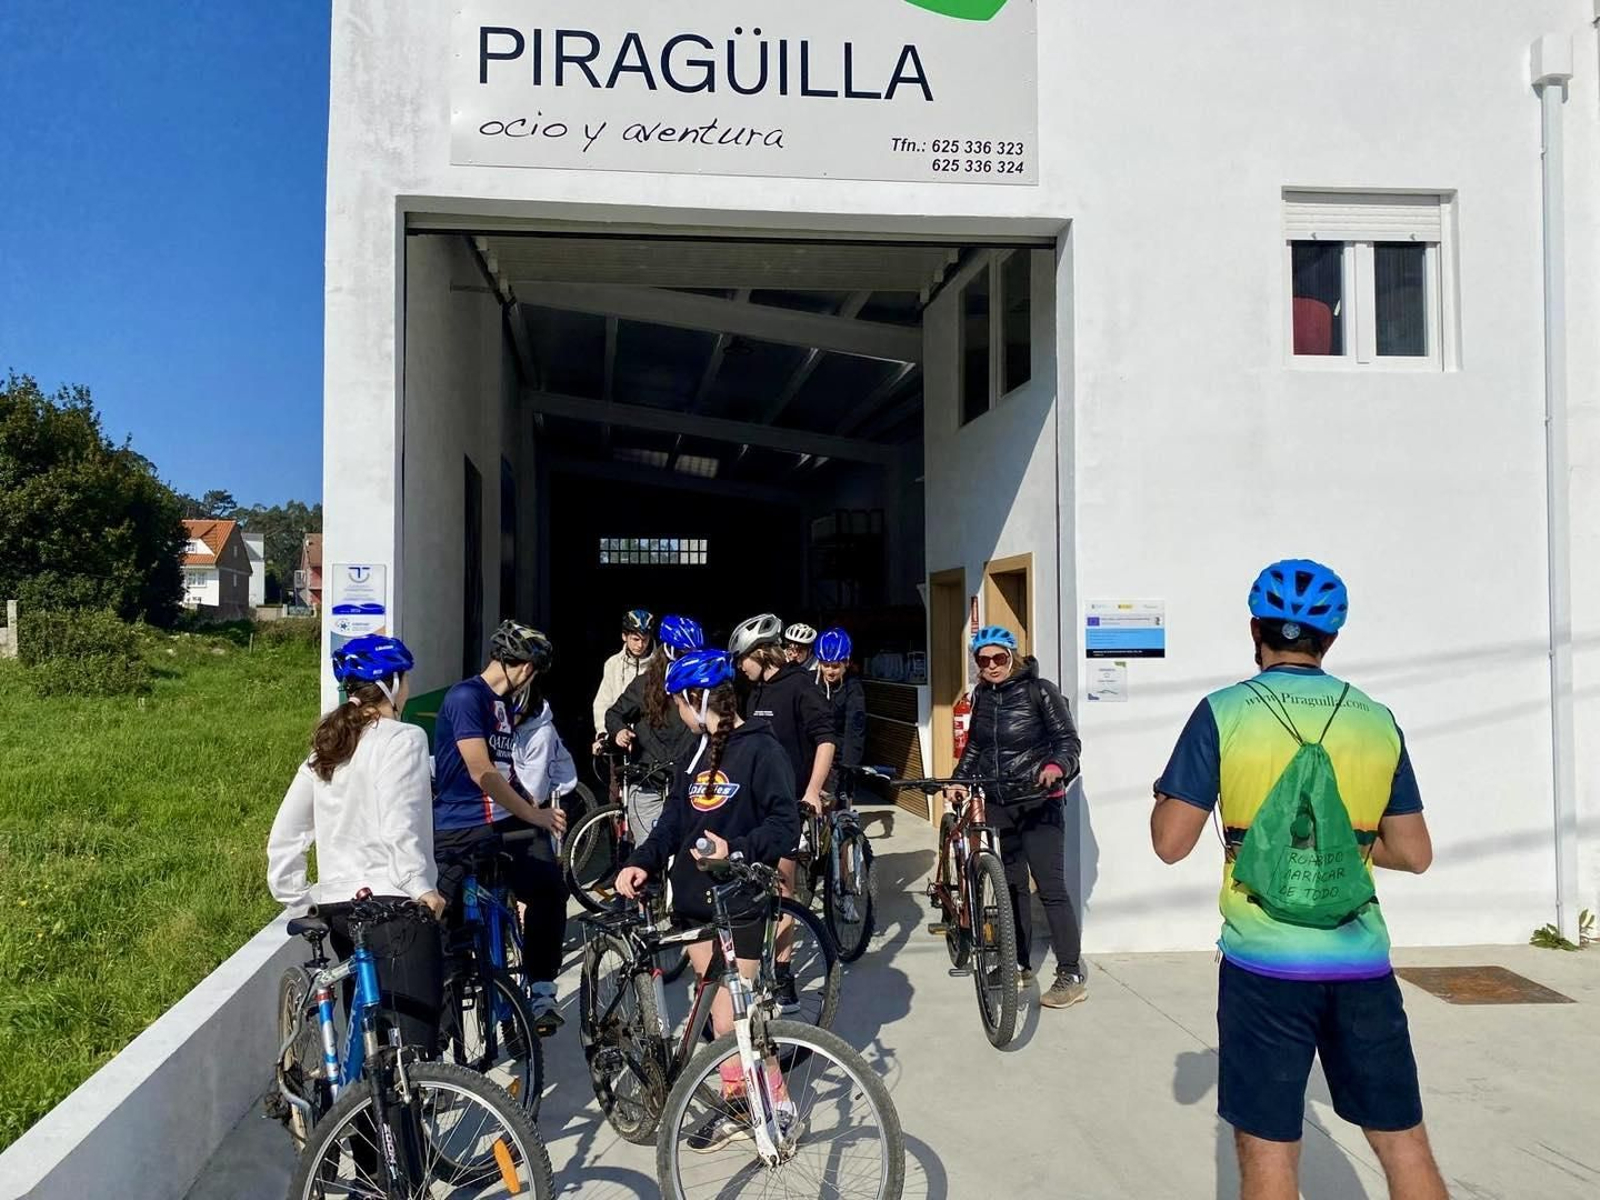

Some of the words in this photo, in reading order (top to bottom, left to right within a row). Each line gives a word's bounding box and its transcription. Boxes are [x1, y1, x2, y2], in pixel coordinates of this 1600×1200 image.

[479, 26, 934, 102] PIRAGÜILLA
[479, 110, 568, 138] ocio
[583, 121, 607, 152] y
[622, 117, 784, 149] aventura
[891, 137, 926, 152] Tfn.:
[931, 139, 960, 153] 625
[964, 140, 992, 155] 336
[996, 141, 1024, 156] 323
[931, 158, 960, 172] 625
[964, 159, 992, 173] 336
[996, 160, 1024, 174] 324
[1245, 692, 1371, 712] wwwPiraguill.com
[690, 784, 731, 795] Dicies
